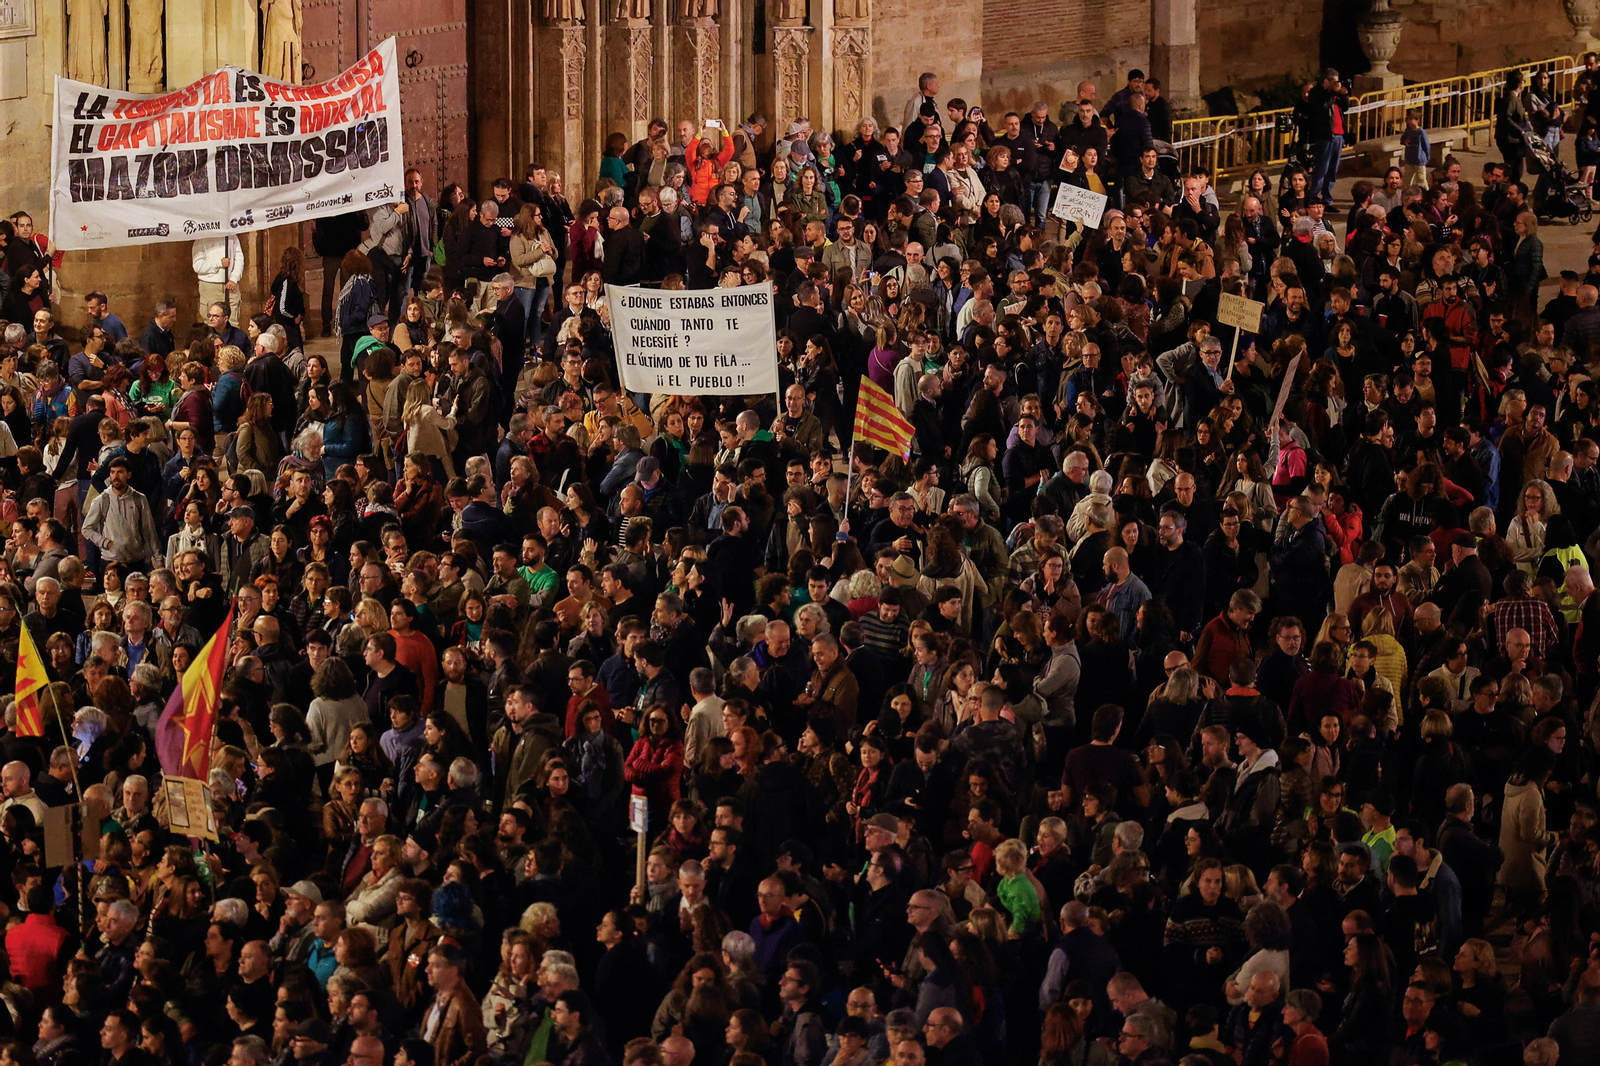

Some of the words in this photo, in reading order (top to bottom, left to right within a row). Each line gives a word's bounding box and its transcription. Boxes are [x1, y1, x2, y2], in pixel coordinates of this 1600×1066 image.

[73, 91, 110, 120] LA
[113, 71, 231, 119] TEMPESTA
[235, 69, 266, 102] ÉS
[264, 49, 385, 102] PERILLOSA
[69, 124, 94, 154] EL
[97, 106, 260, 151] CAPITALISME
[265, 102, 295, 136] ÉS
[300, 81, 387, 134] MORTAL
[68, 144, 209, 203] MAZÓN
[215, 113, 389, 192] DIMISSIÓ!
[197, 221, 221, 232] ARRAN
[670, 296, 714, 310] ESTABAS
[721, 293, 768, 307] ENTONCES
[630, 317, 670, 331] CUÁNDO
[681, 318, 713, 331] TANTO
[726, 318, 739, 330] TE
[627, 353, 636, 366] EL
[679, 357, 691, 368] DE
[695, 356, 707, 368] TU
[669, 375, 681, 387] EL
[690, 375, 732, 388] PUEBLO
